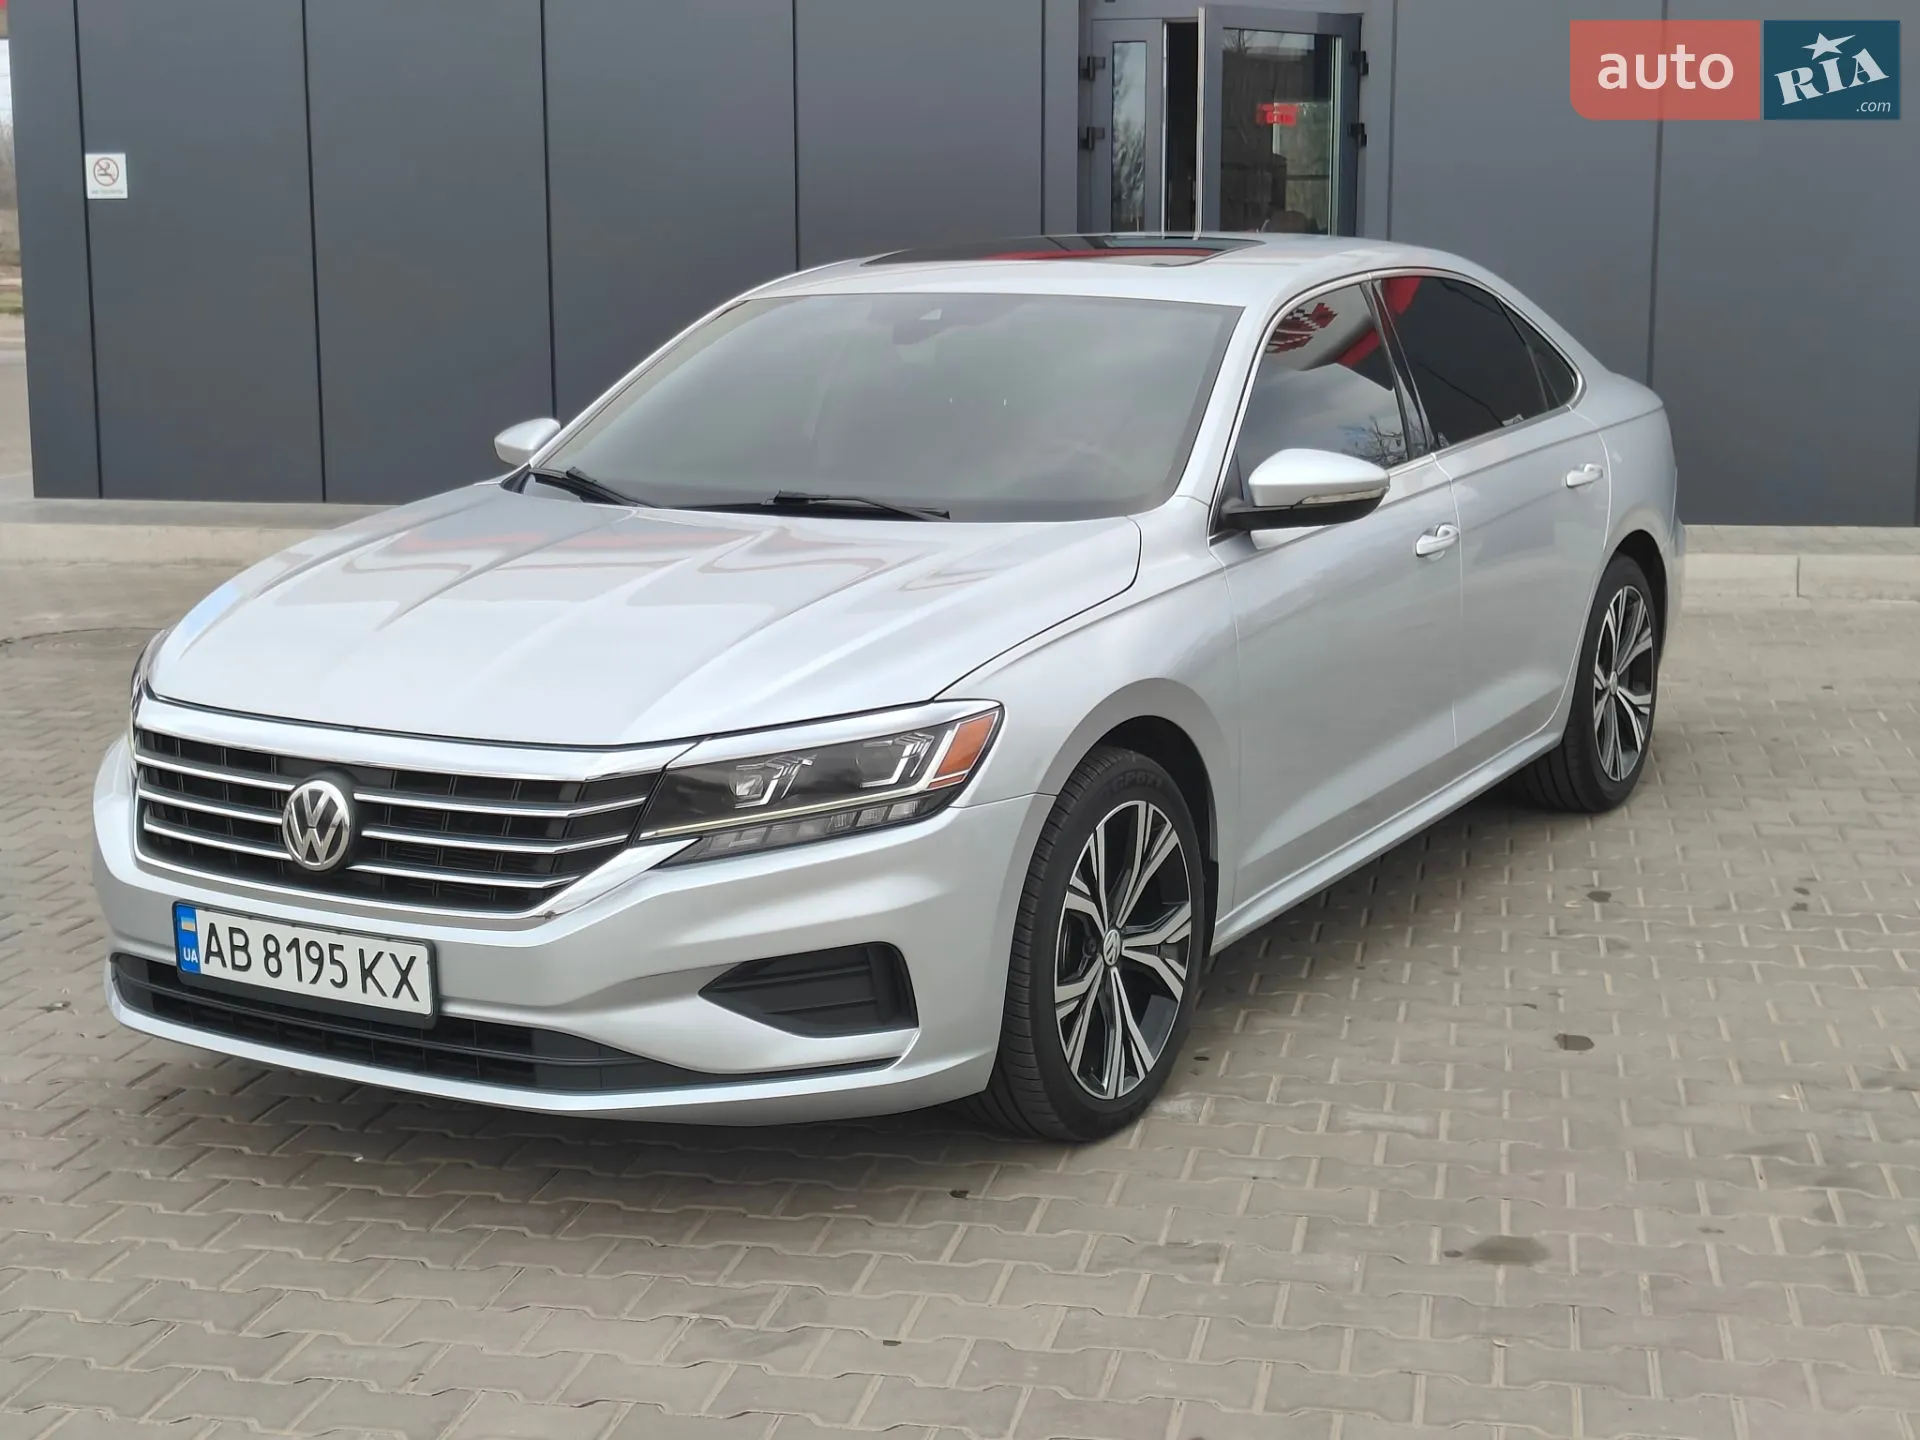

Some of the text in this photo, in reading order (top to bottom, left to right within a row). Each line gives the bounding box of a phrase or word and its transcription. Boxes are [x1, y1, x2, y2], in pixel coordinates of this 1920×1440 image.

[183, 947, 198, 964] UA
[204, 922, 420, 1002] AB 8195 KX
